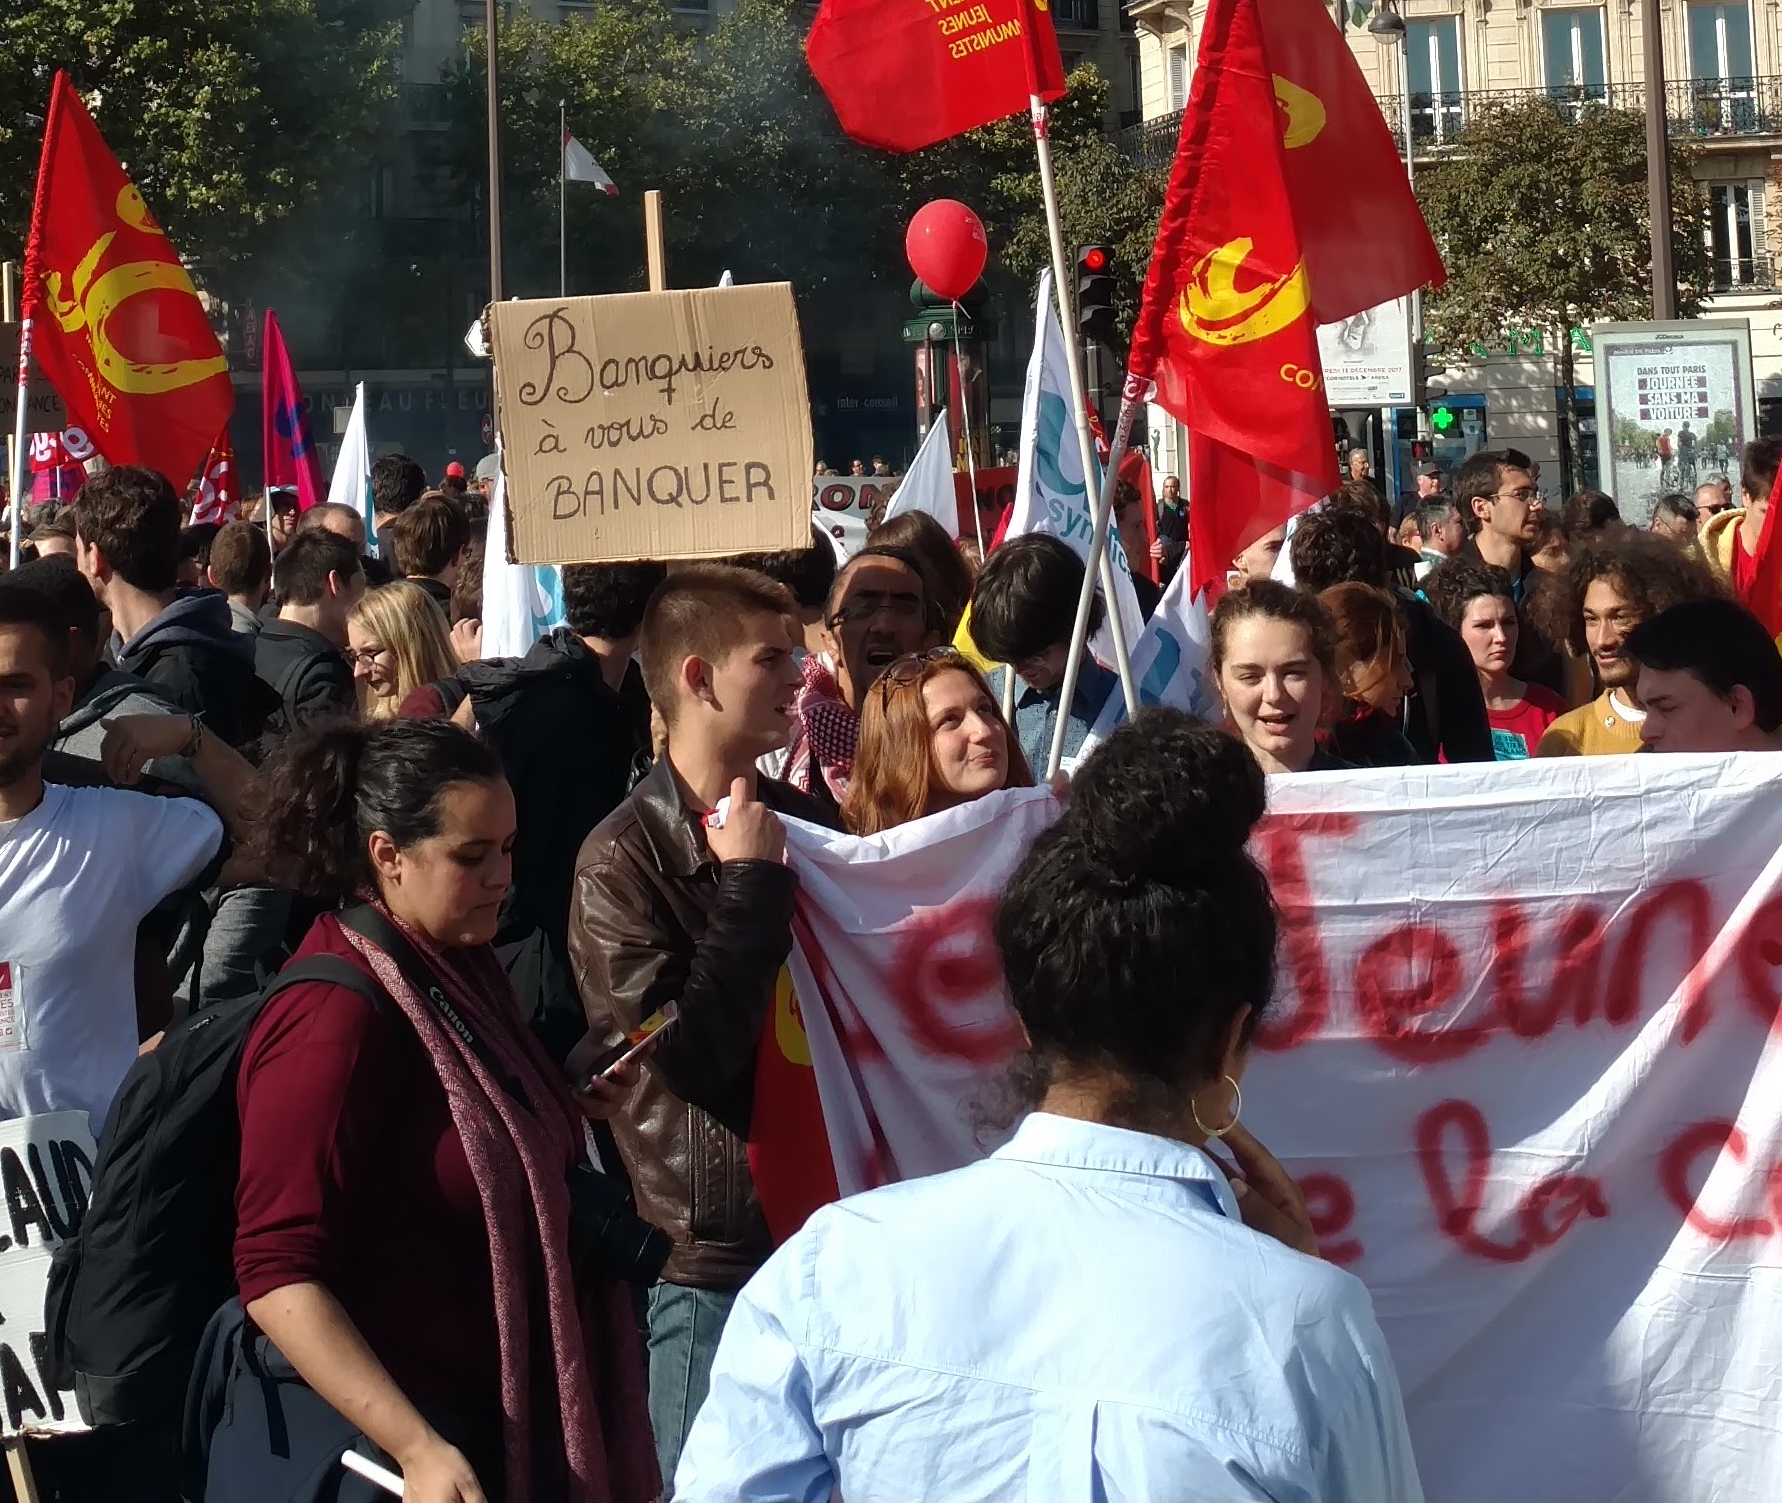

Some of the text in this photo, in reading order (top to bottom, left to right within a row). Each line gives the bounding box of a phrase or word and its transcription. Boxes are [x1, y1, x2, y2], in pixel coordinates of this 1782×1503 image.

[519, 306, 774, 406] Banquiers
[1637, 365, 1706, 375] DANS TOUT PARIS
[425, 389, 489, 411] FLEU
[1647, 391, 1699, 405] SANS MA
[1649, 407, 1699, 420] VOITURE
[534, 396, 737, 456] à vous de
[545, 461, 776, 521] BANQUER
[428, 986, 476, 1046] Canon
